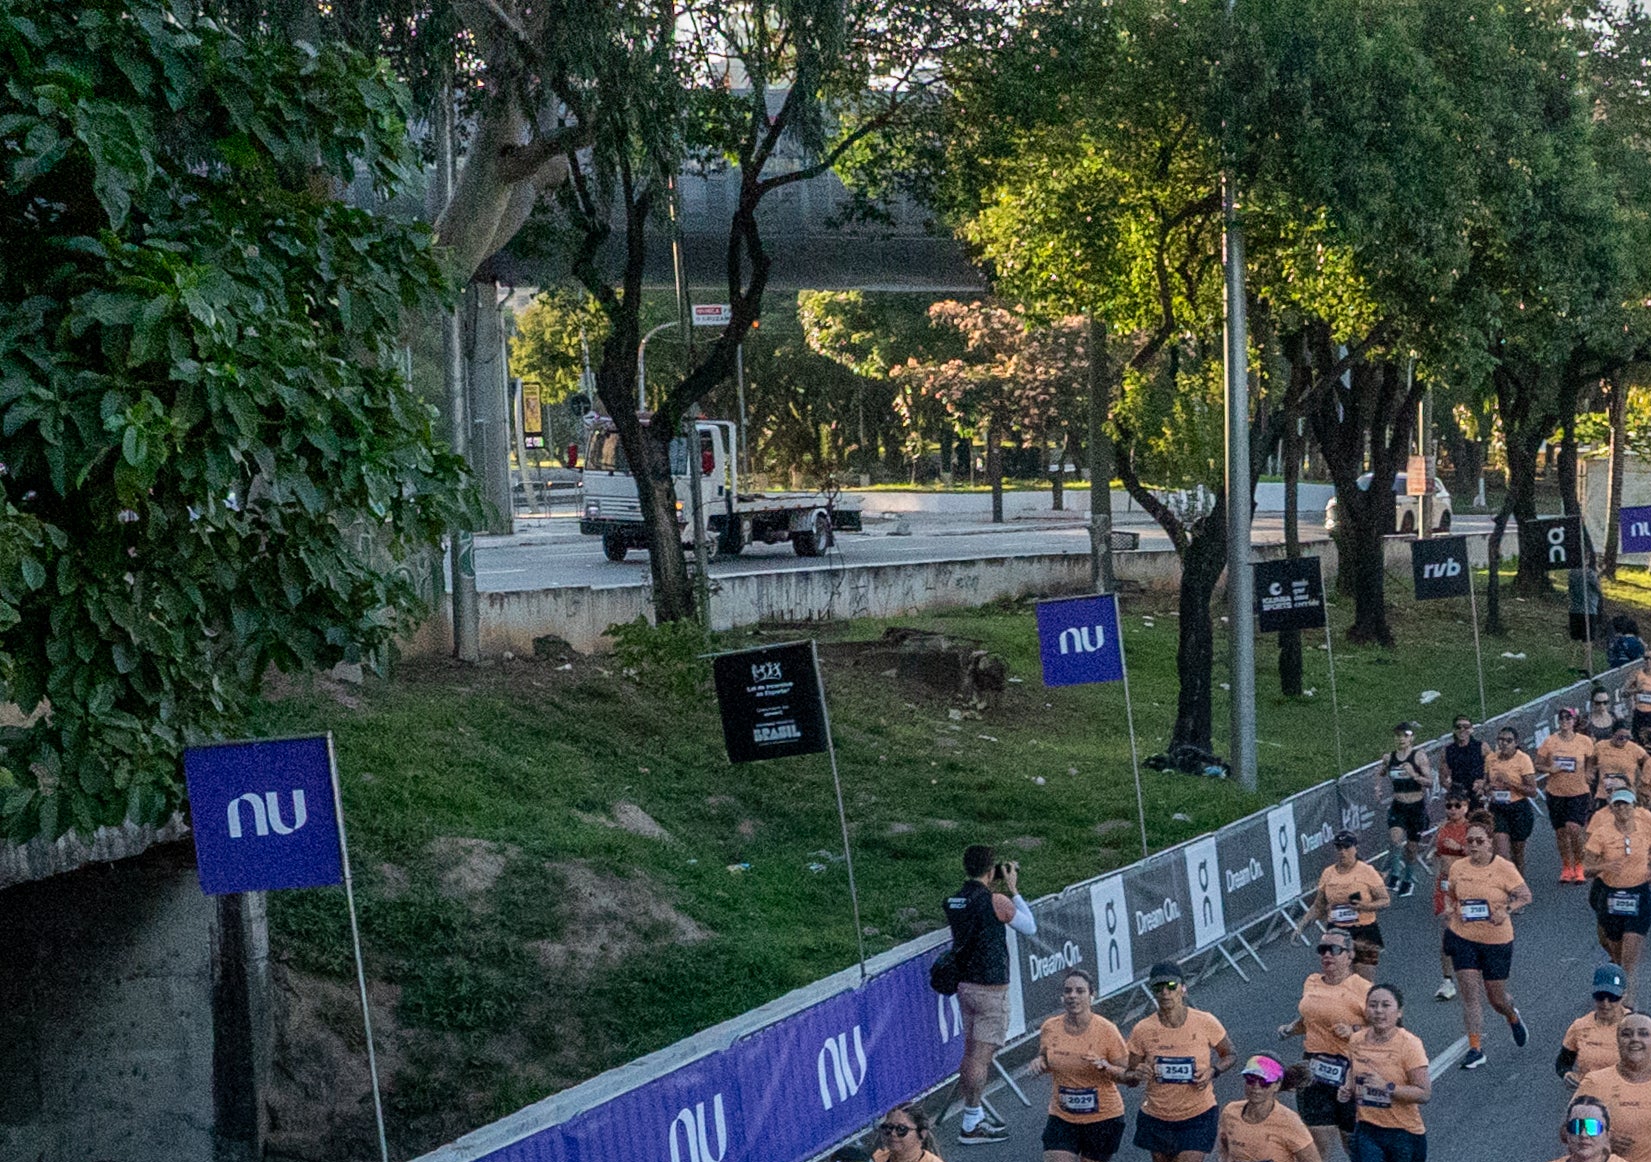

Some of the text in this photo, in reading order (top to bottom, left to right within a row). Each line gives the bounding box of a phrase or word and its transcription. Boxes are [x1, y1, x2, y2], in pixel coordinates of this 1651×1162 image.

[1423, 558, 1462, 580] rvb
[1059, 624, 1105, 655] nu
[753, 724, 802, 743] BRASIL
[227, 788, 307, 840] nu
[1225, 867, 1251, 893] Dream
[1135, 908, 1165, 936] Dream
[1029, 952, 1066, 982] Dream
[817, 1025, 868, 1111] nu
[1165, 1065, 1189, 1075] 2543
